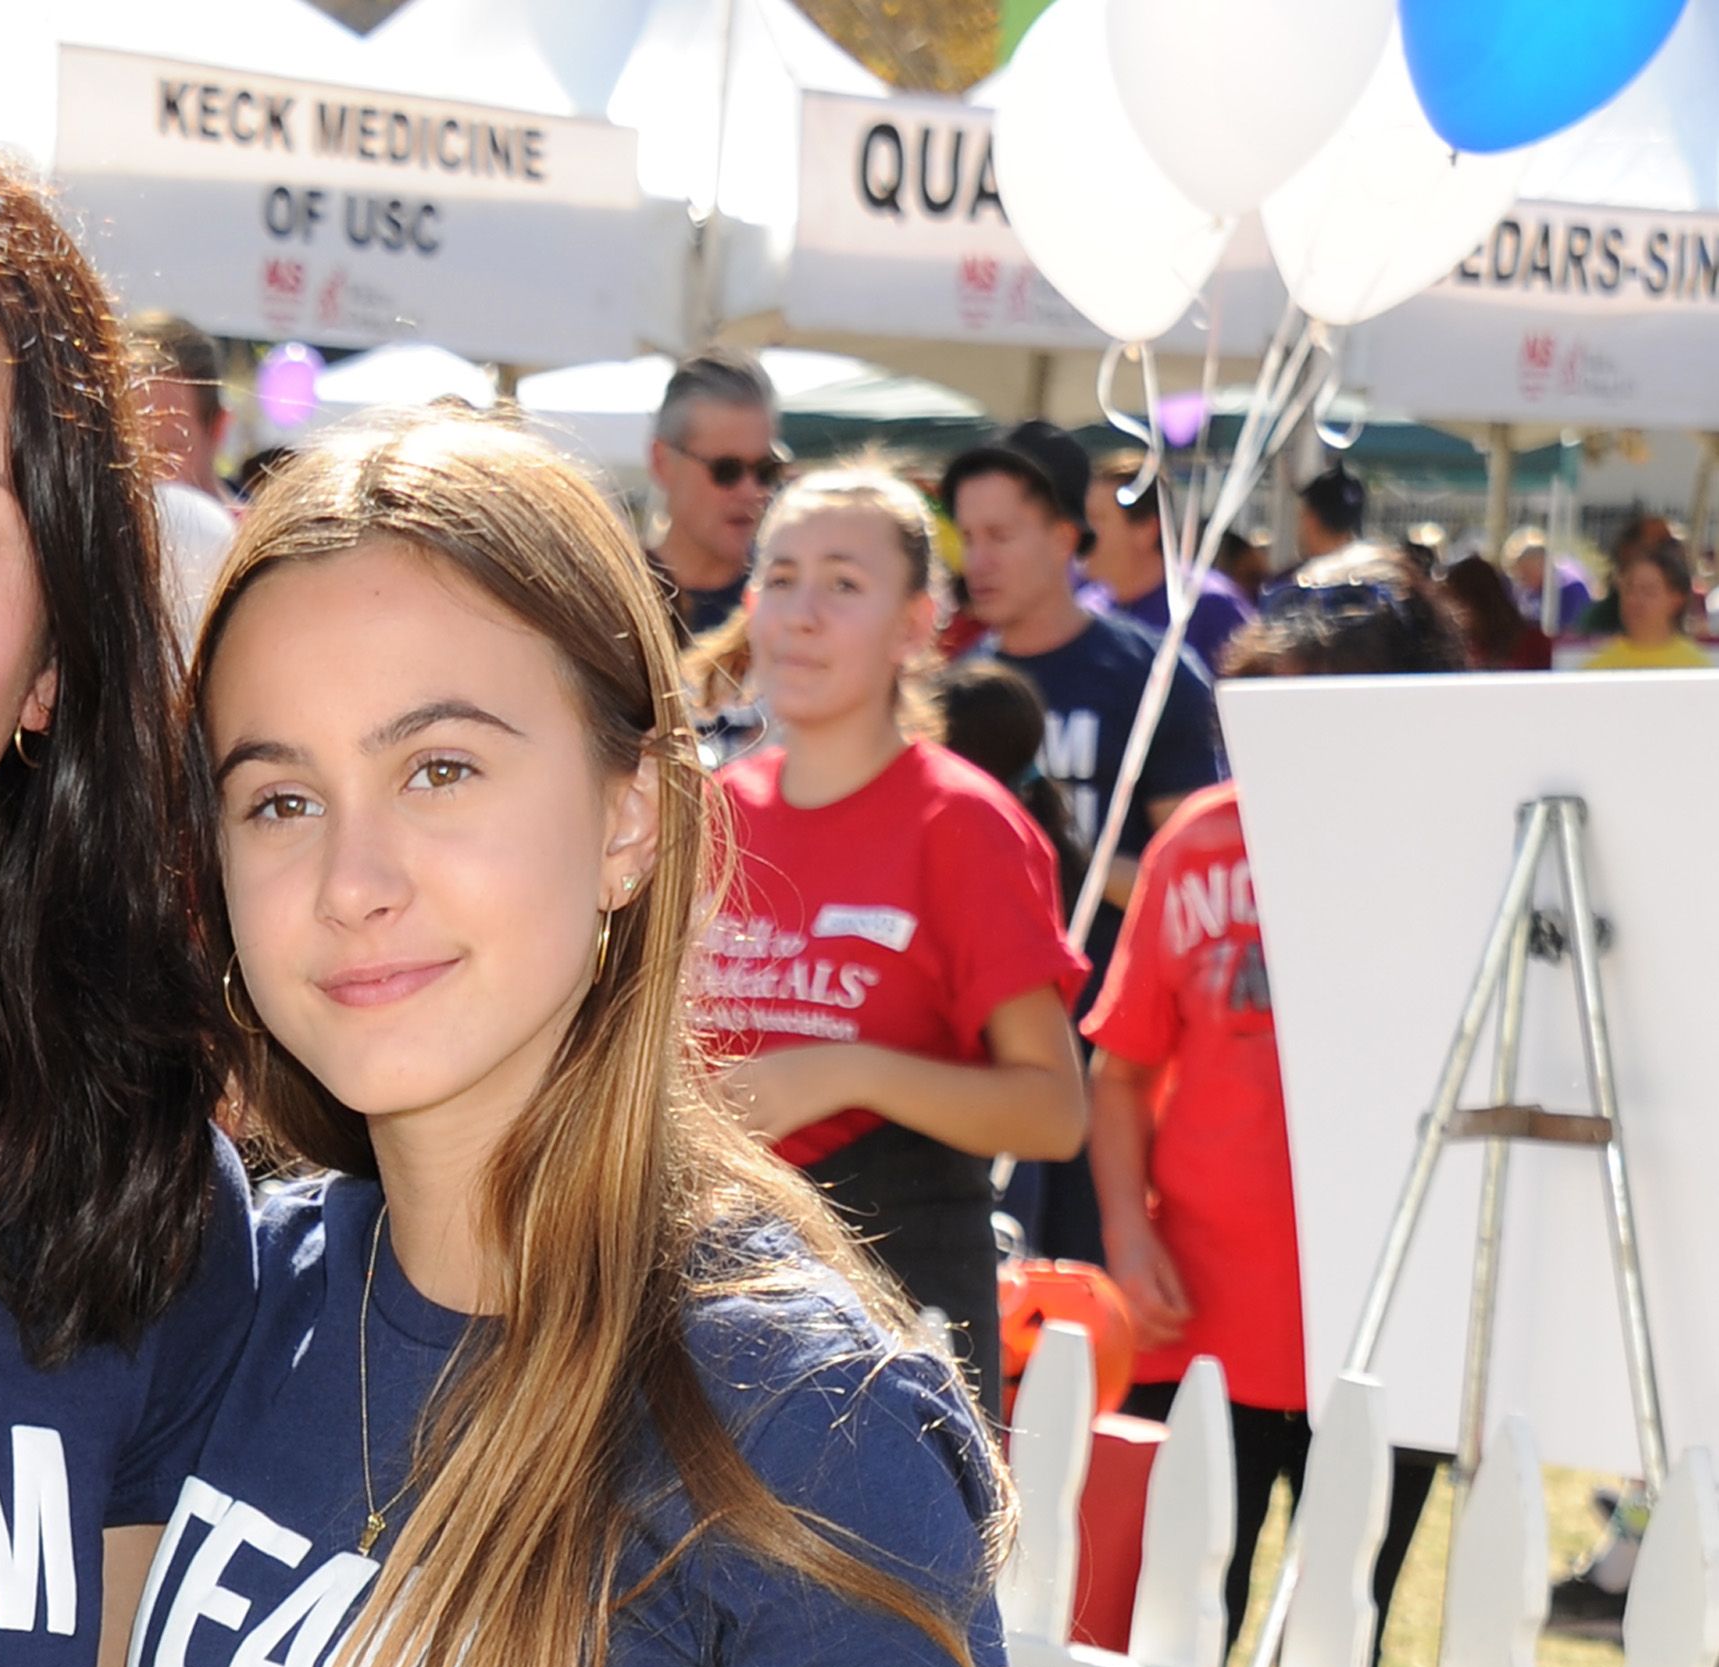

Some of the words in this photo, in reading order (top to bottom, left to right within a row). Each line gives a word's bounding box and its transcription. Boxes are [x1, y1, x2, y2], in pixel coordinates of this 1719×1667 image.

[158, 76, 294, 152] KECK
[314, 100, 548, 182] MEDICINE
[263, 185, 325, 244] OF
[345, 195, 443, 256] USC
